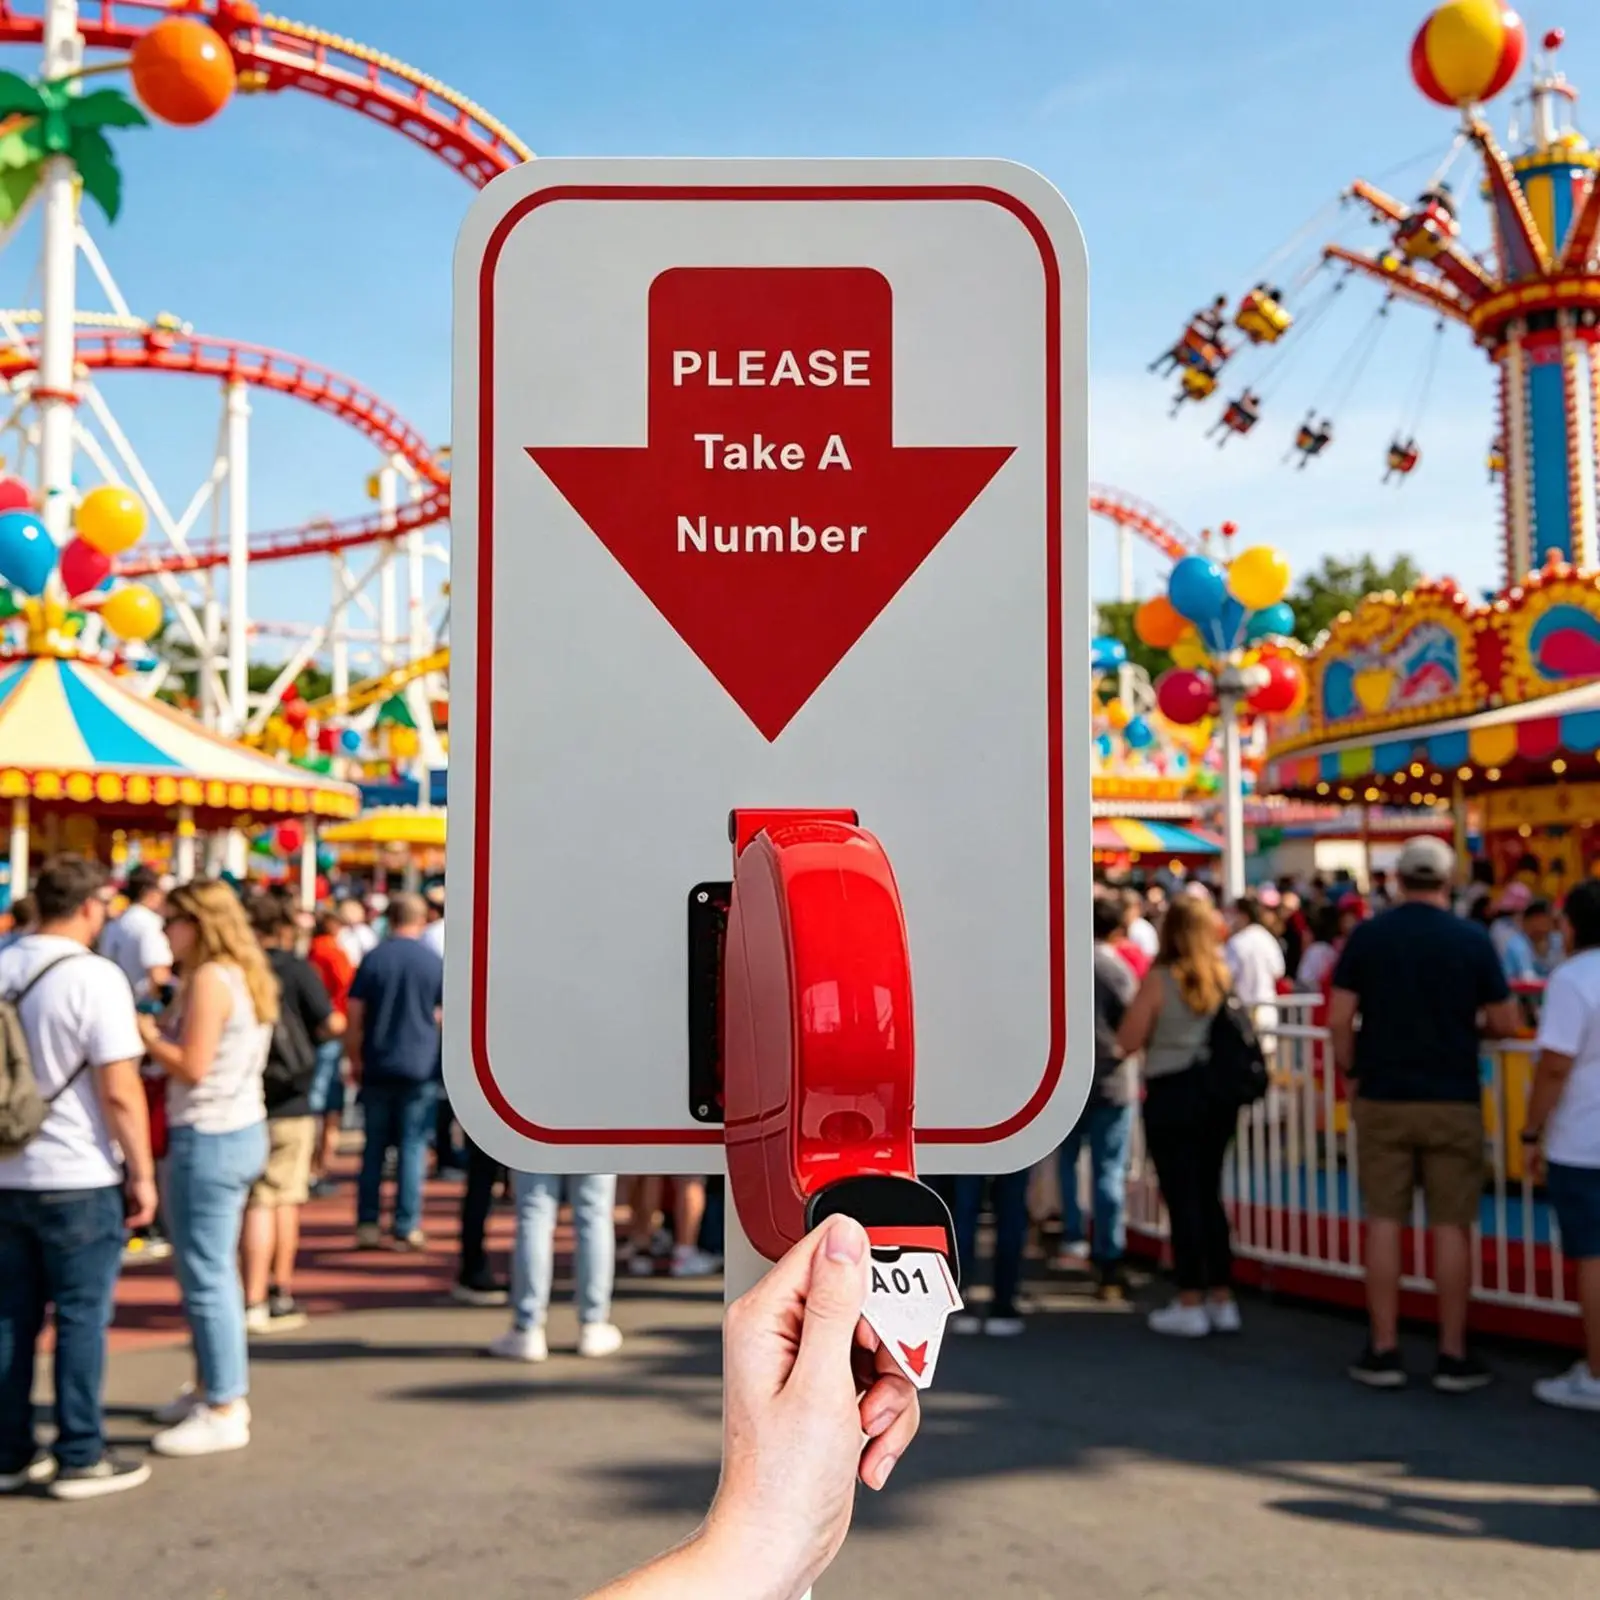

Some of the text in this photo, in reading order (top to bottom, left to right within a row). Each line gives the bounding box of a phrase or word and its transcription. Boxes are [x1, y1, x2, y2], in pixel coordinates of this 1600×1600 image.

[672, 349, 871, 386] PLEASE
[694, 433, 852, 470] Take A
[677, 515, 868, 553] Number
[871, 1265, 929, 1294] A01
